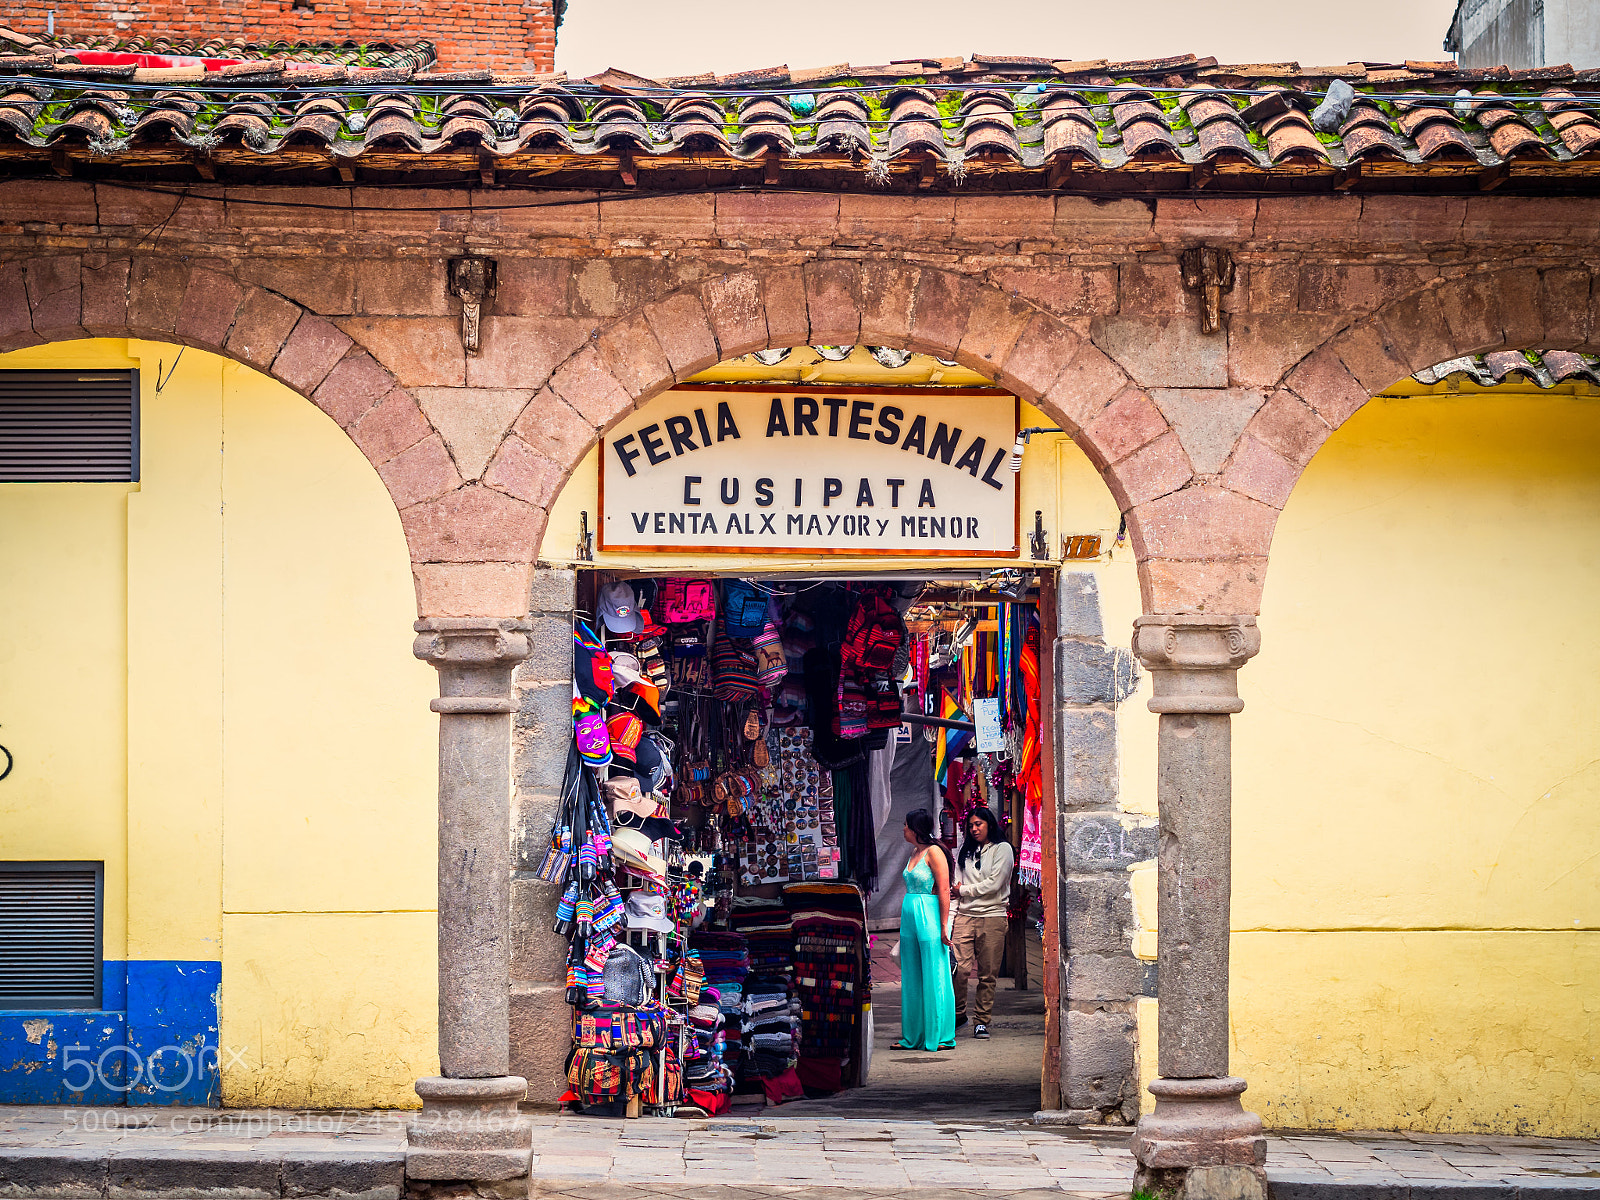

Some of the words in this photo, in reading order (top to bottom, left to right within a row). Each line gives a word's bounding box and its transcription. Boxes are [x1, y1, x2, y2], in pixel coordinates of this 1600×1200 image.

[613, 402, 741, 477] FERIA
[766, 397, 1006, 491] ARTESANAL
[684, 476, 936, 508] CUSIPATA
[631, 512, 718, 535] VENTA
[901, 516, 979, 539] MENOR
